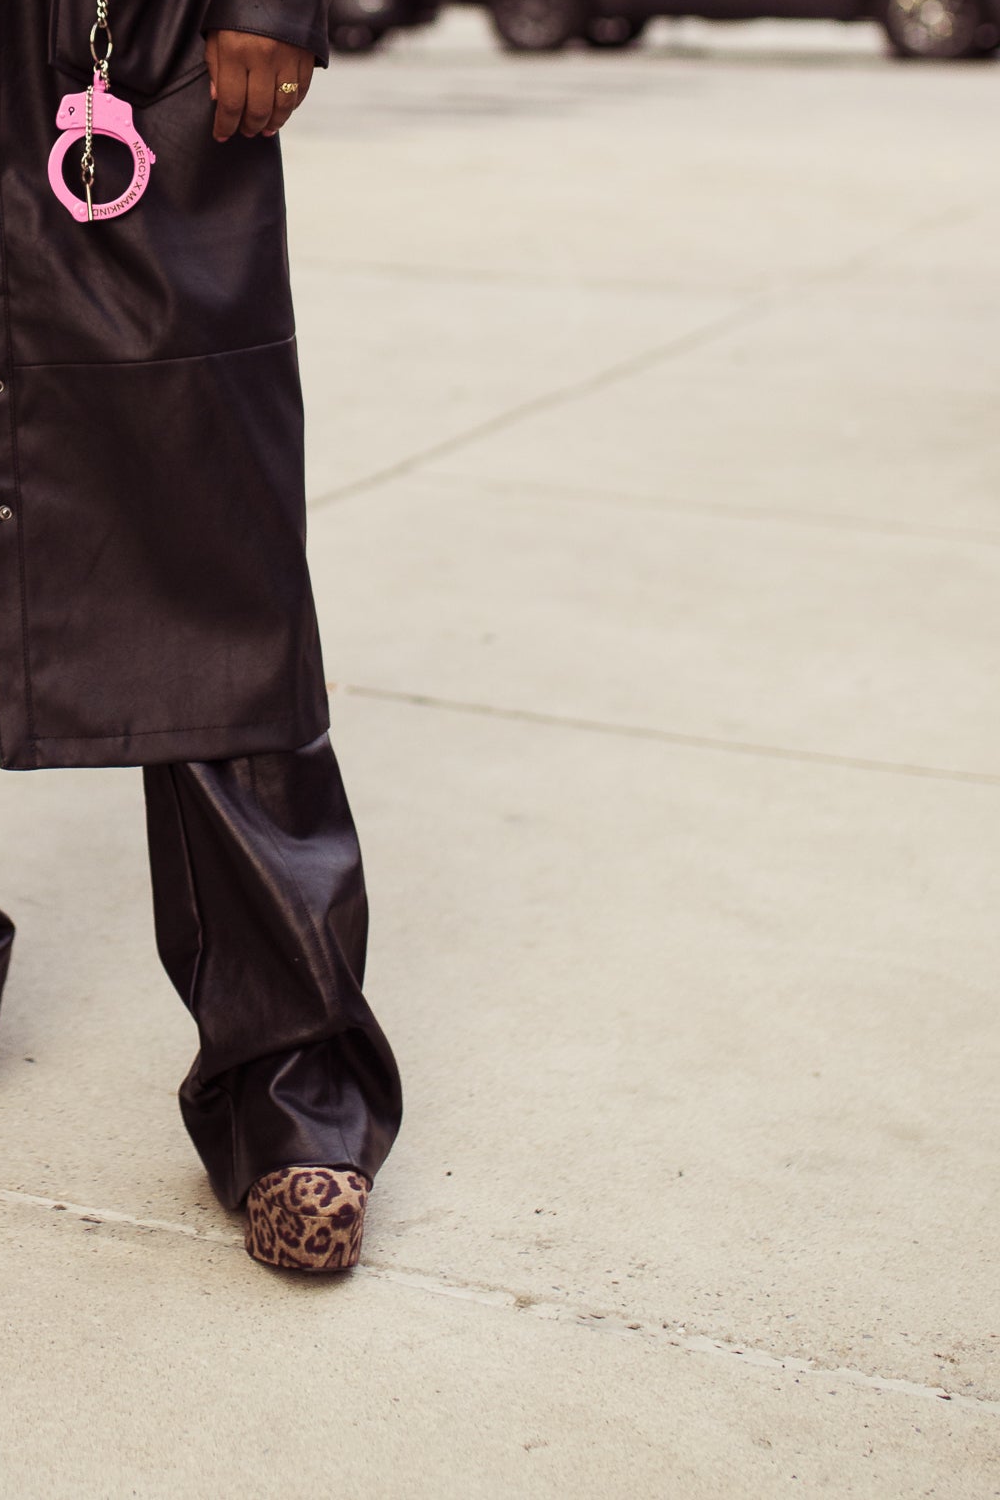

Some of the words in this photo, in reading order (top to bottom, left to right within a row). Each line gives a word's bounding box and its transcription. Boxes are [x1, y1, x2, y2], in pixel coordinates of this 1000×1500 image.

[133, 141, 146, 181] MERCY
[133, 181, 142, 190] X
[92, 190, 137, 216] MANKIND
